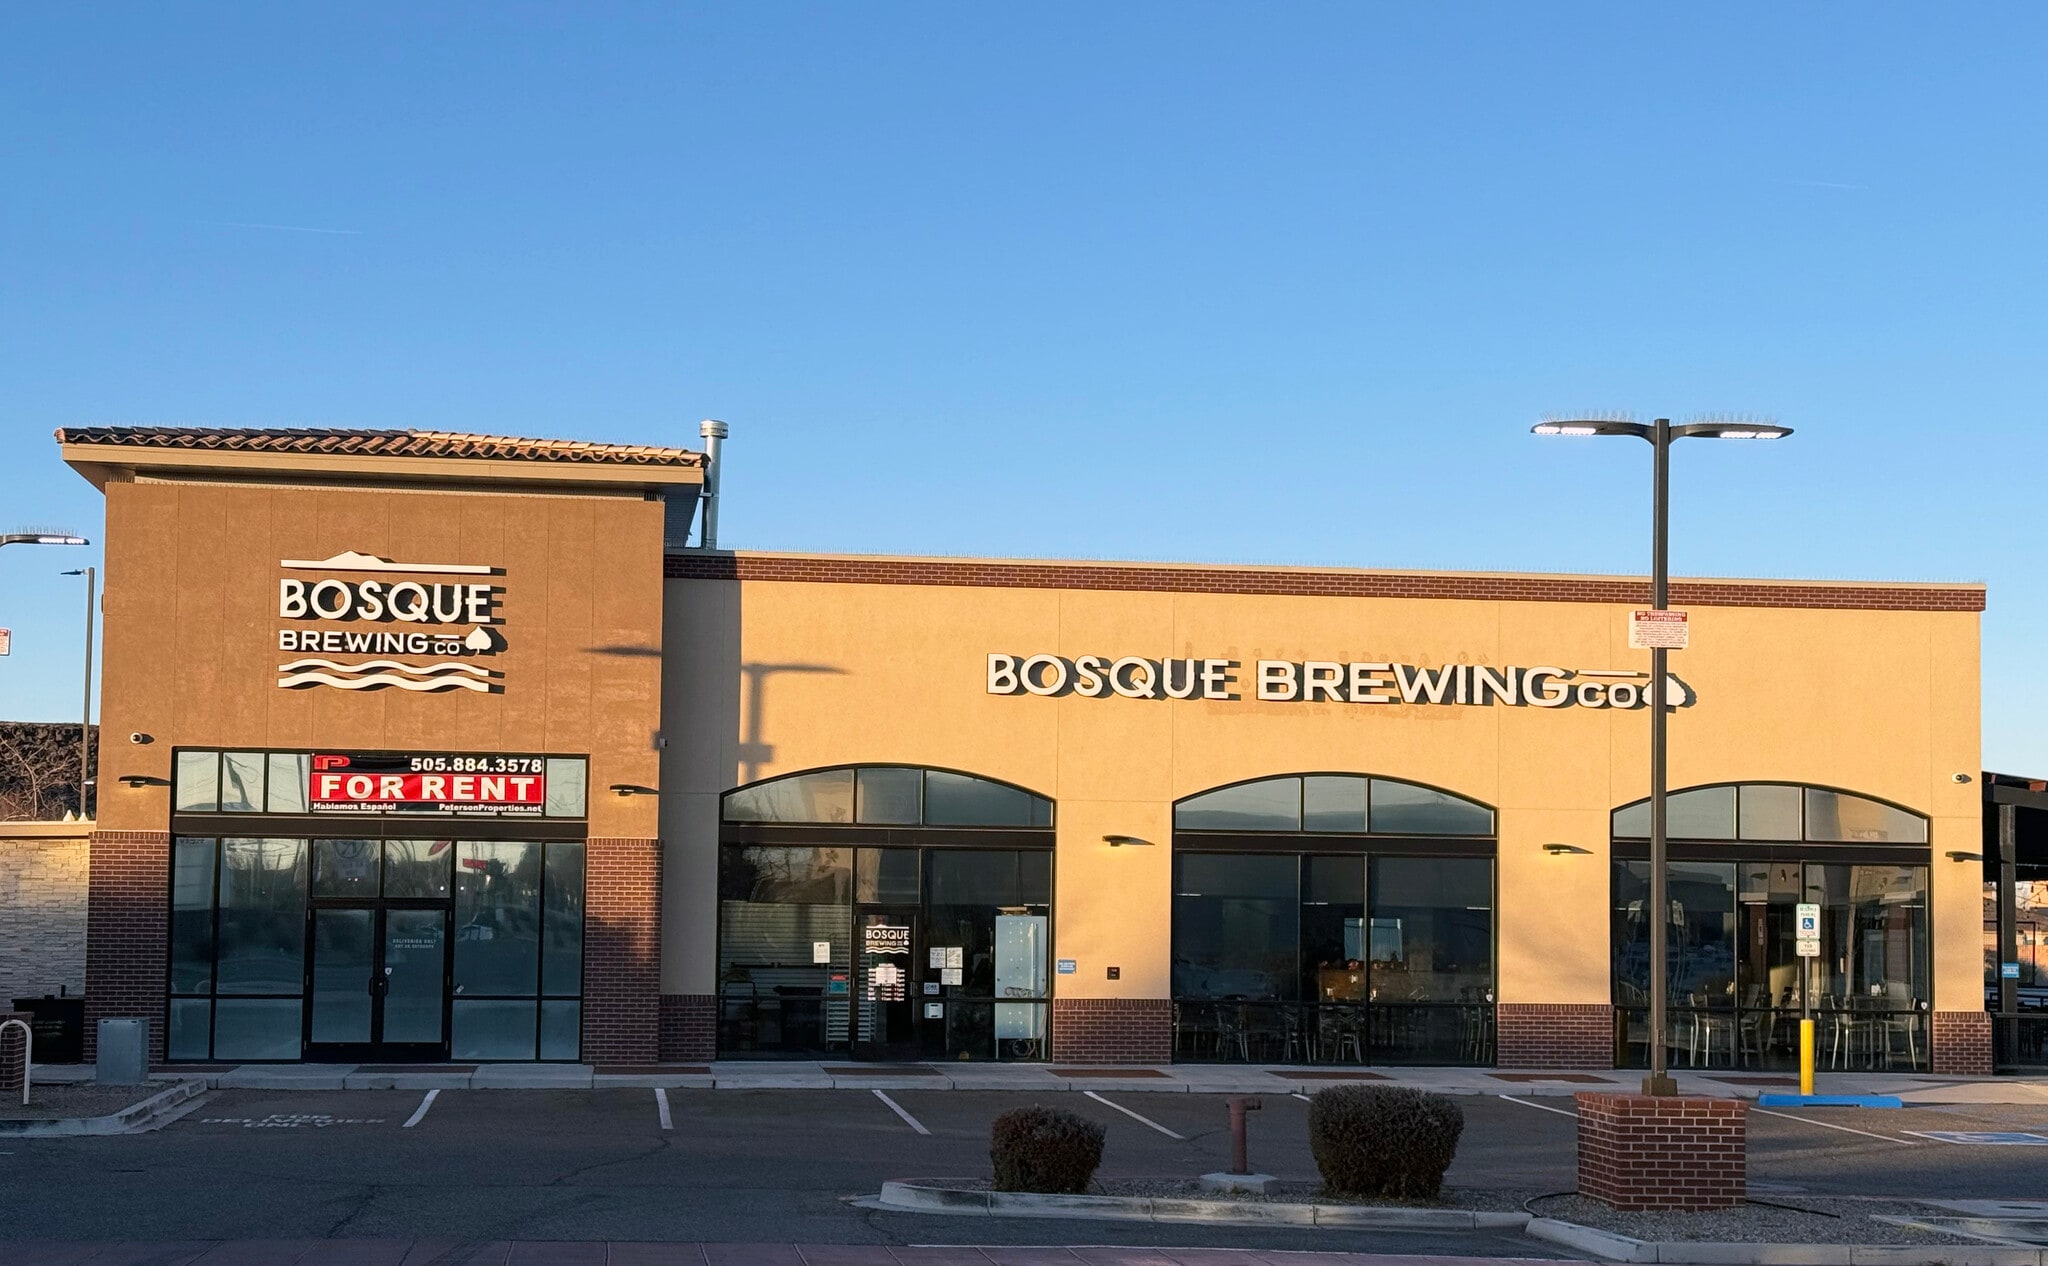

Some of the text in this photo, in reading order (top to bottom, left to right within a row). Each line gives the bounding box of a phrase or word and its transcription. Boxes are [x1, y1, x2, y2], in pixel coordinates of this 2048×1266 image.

[280, 578, 491, 622] BOSQUE
[279, 629, 460, 655] BREWING CO
[987, 653, 1638, 709] BOSQUE BREWING CO
[410, 757, 542, 773] 505.884.3578
[320, 775, 535, 801] FOR RENT
[360, 803, 396, 812] Español
[439, 803, 543, 813] PetersonProperties.net
[866, 929, 909, 940] BOSQUE
